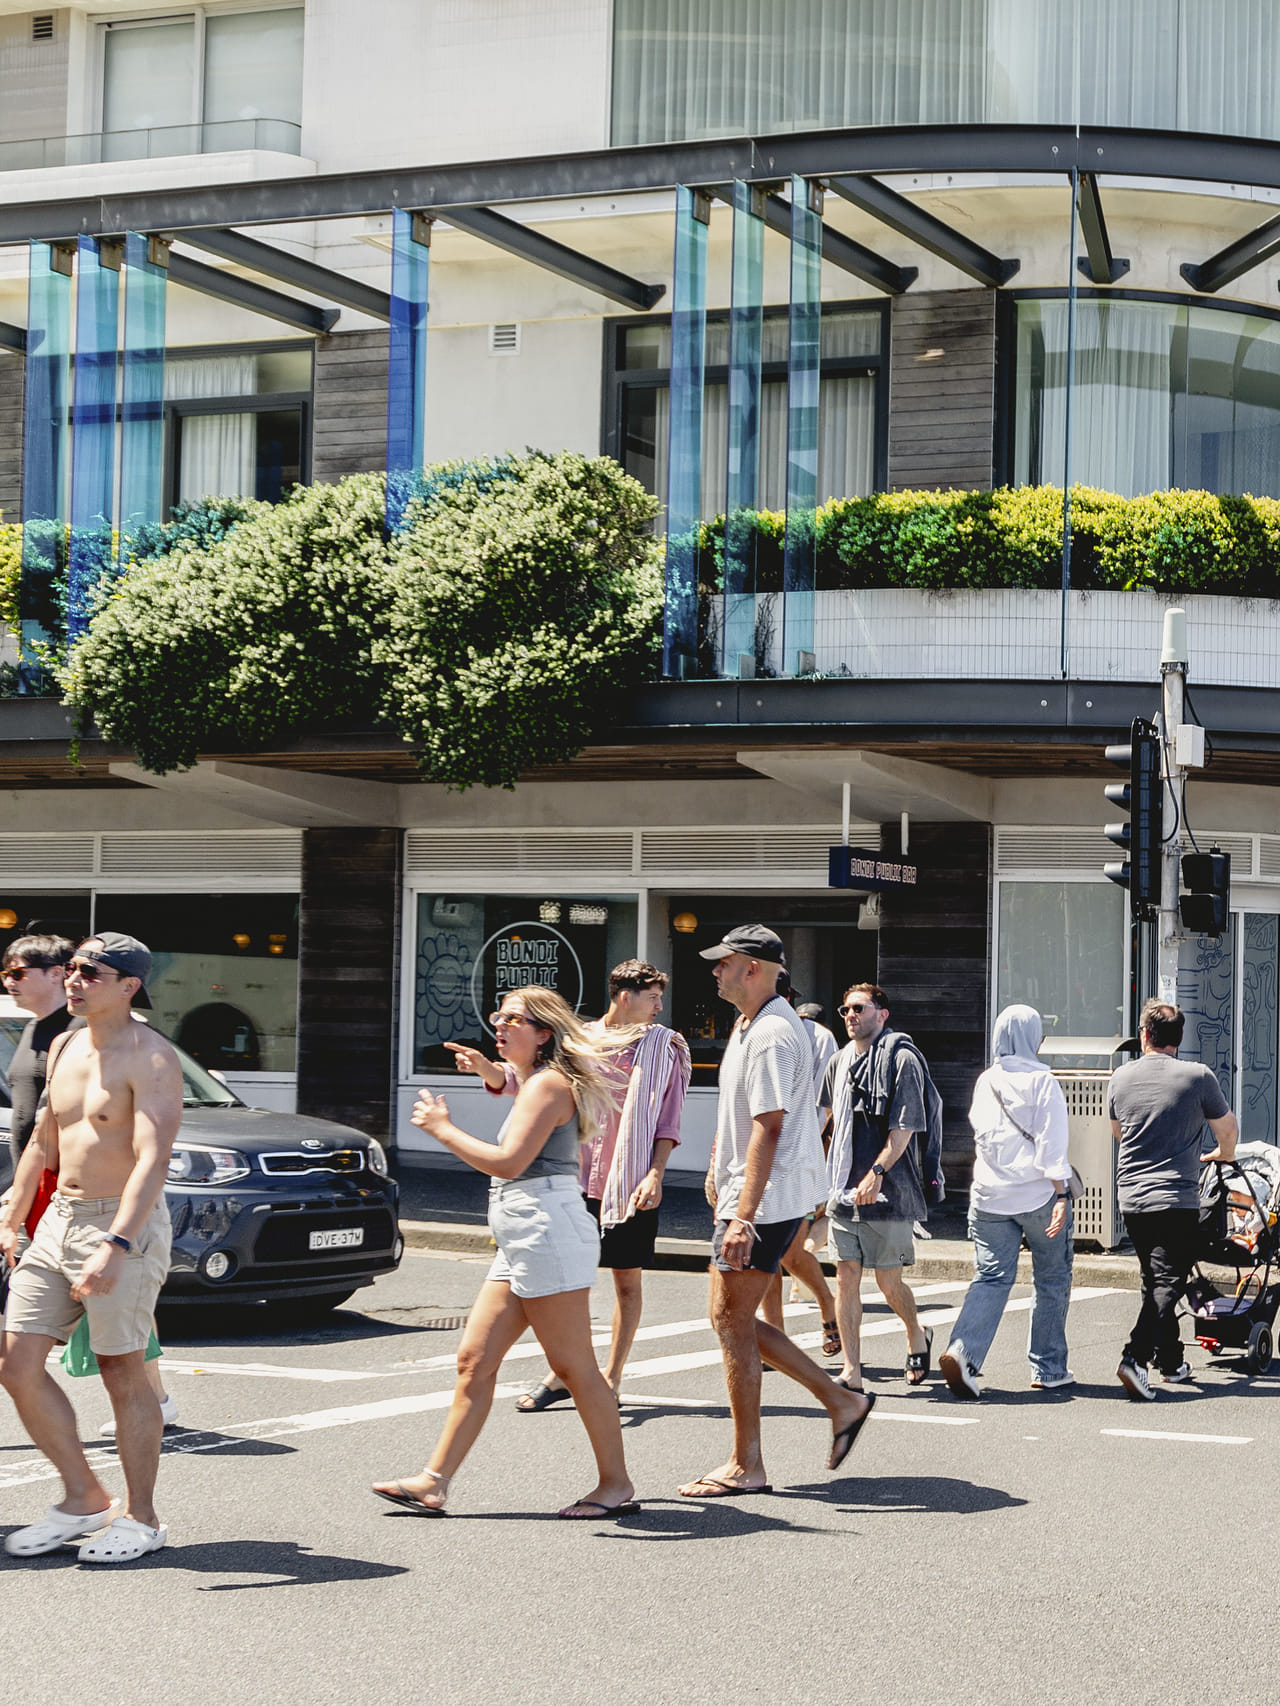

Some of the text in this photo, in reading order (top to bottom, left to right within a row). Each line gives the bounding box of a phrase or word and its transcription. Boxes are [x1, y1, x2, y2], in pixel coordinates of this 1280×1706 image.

[851, 858, 917, 884] BONDI PUBLIC BAR
[497, 939, 560, 964] BONDI
[496, 966, 559, 989] PUBLIC
